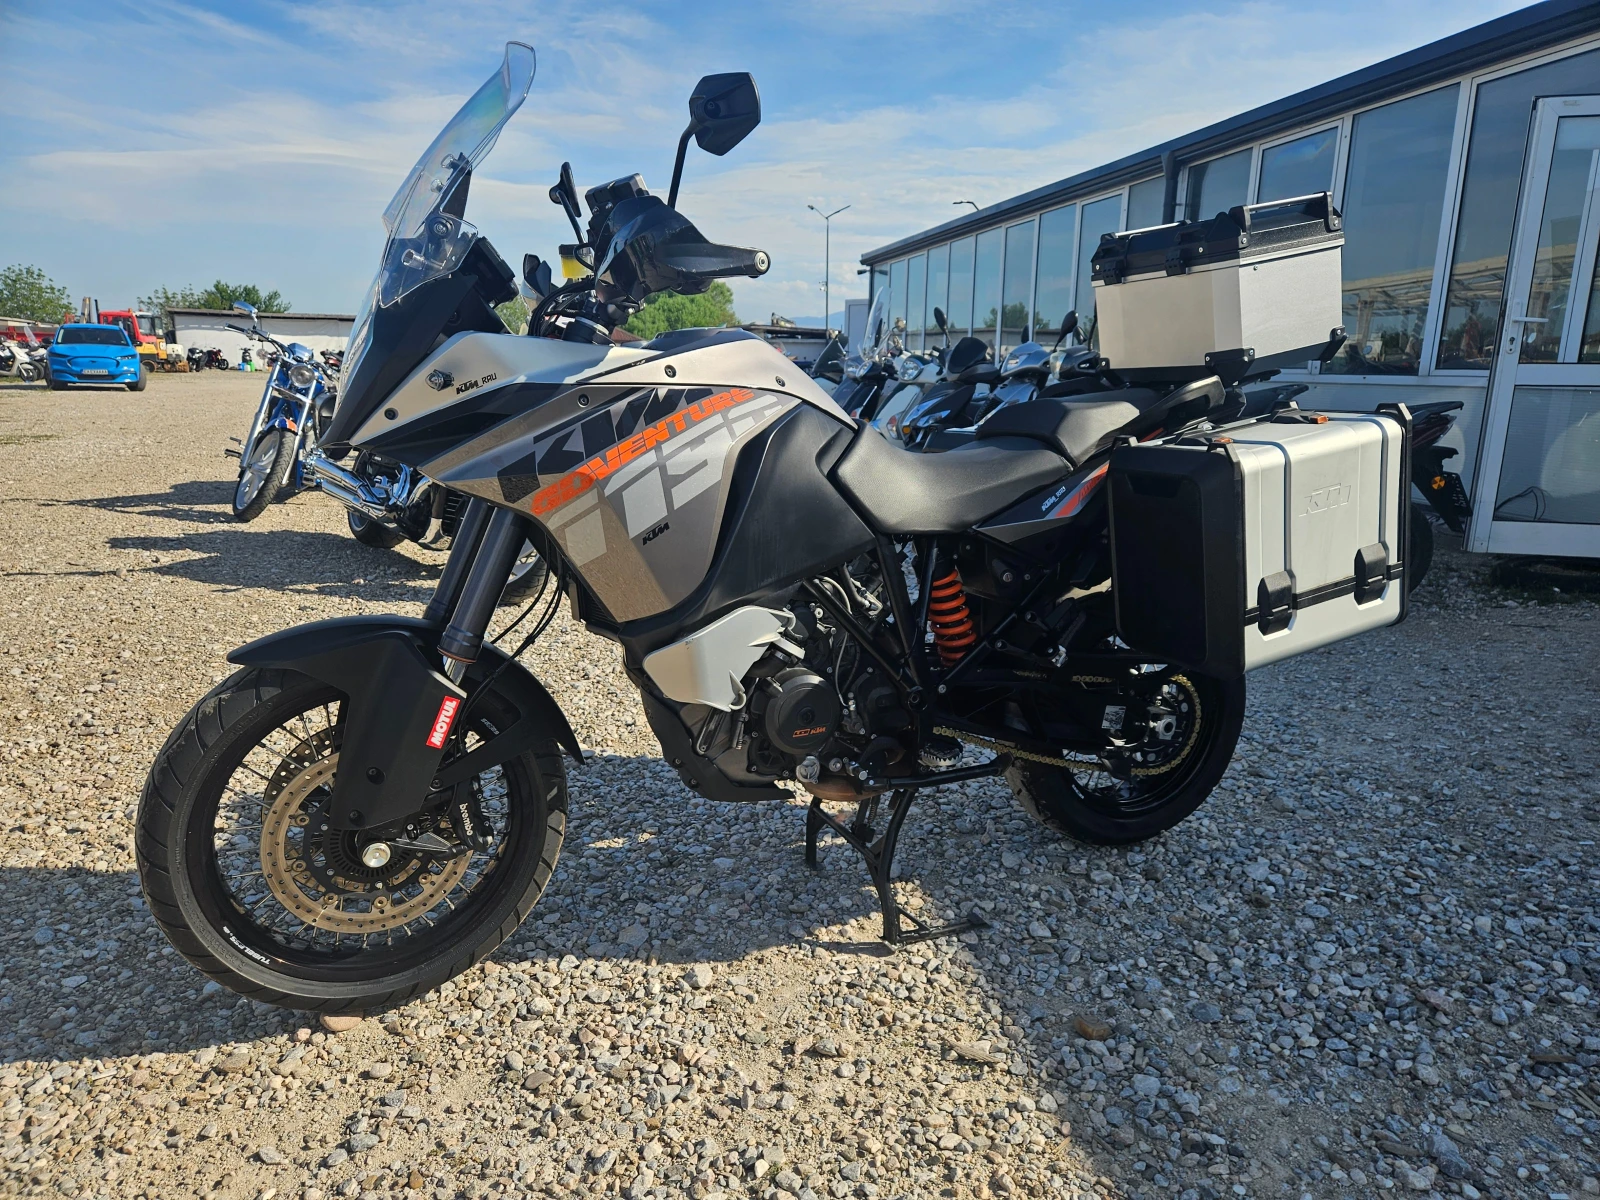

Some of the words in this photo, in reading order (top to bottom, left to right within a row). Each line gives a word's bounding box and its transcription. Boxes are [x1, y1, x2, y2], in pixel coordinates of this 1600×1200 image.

[530, 387, 755, 516] ADVENTURE
[642, 521, 670, 546] KTM
[430, 700, 457, 747] MOTUL
[459, 802, 474, 836] brembo
